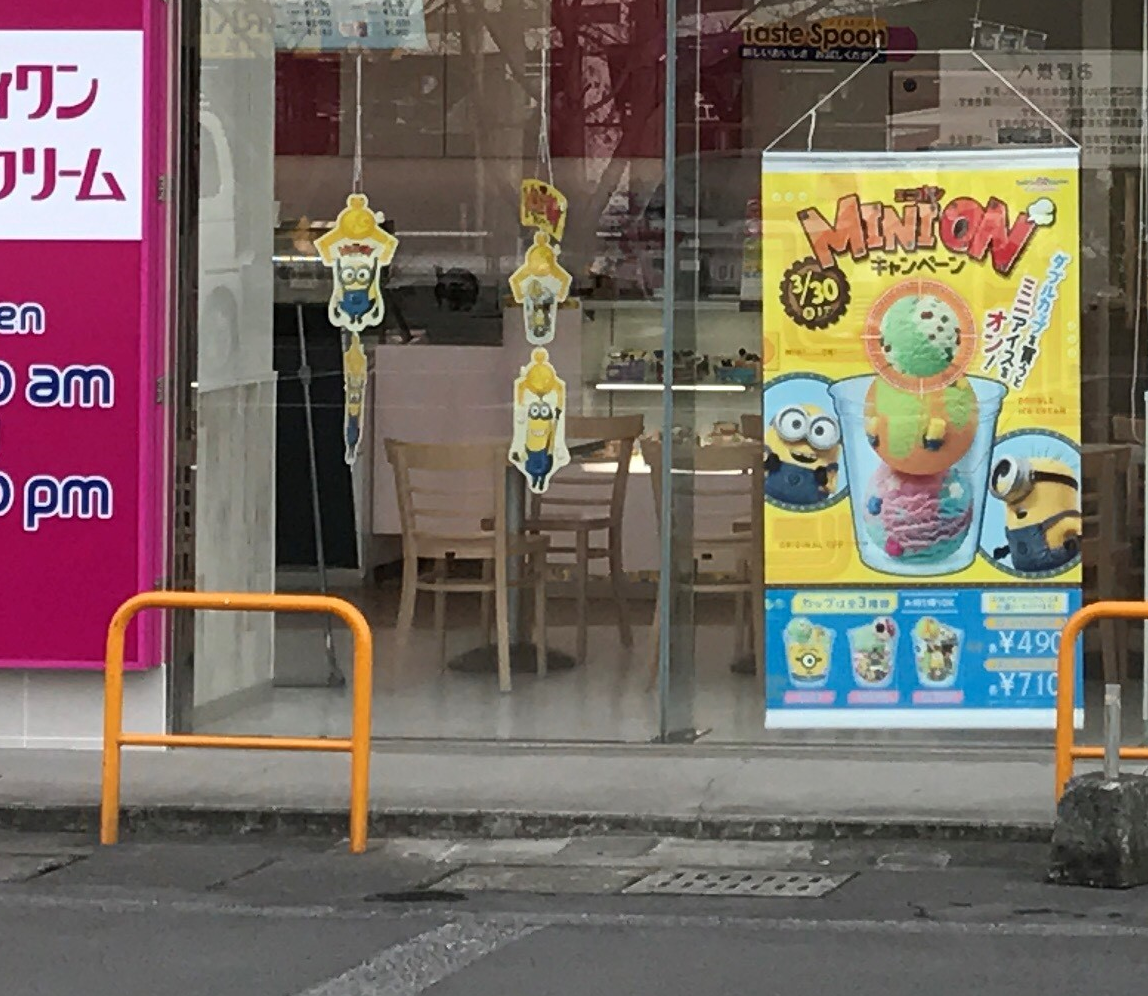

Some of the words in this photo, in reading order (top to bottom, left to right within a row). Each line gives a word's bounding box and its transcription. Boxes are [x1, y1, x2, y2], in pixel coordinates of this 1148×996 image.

[744, 21, 804, 45] Taste
[809, 22, 887, 51] Spoon
[797, 192, 1038, 278] MINION
[870, 256, 967, 276] キャンペーン
[789, 269, 839, 307] 3/30
[26, 365, 113, 407] am
[24, 475, 113, 531] pm
